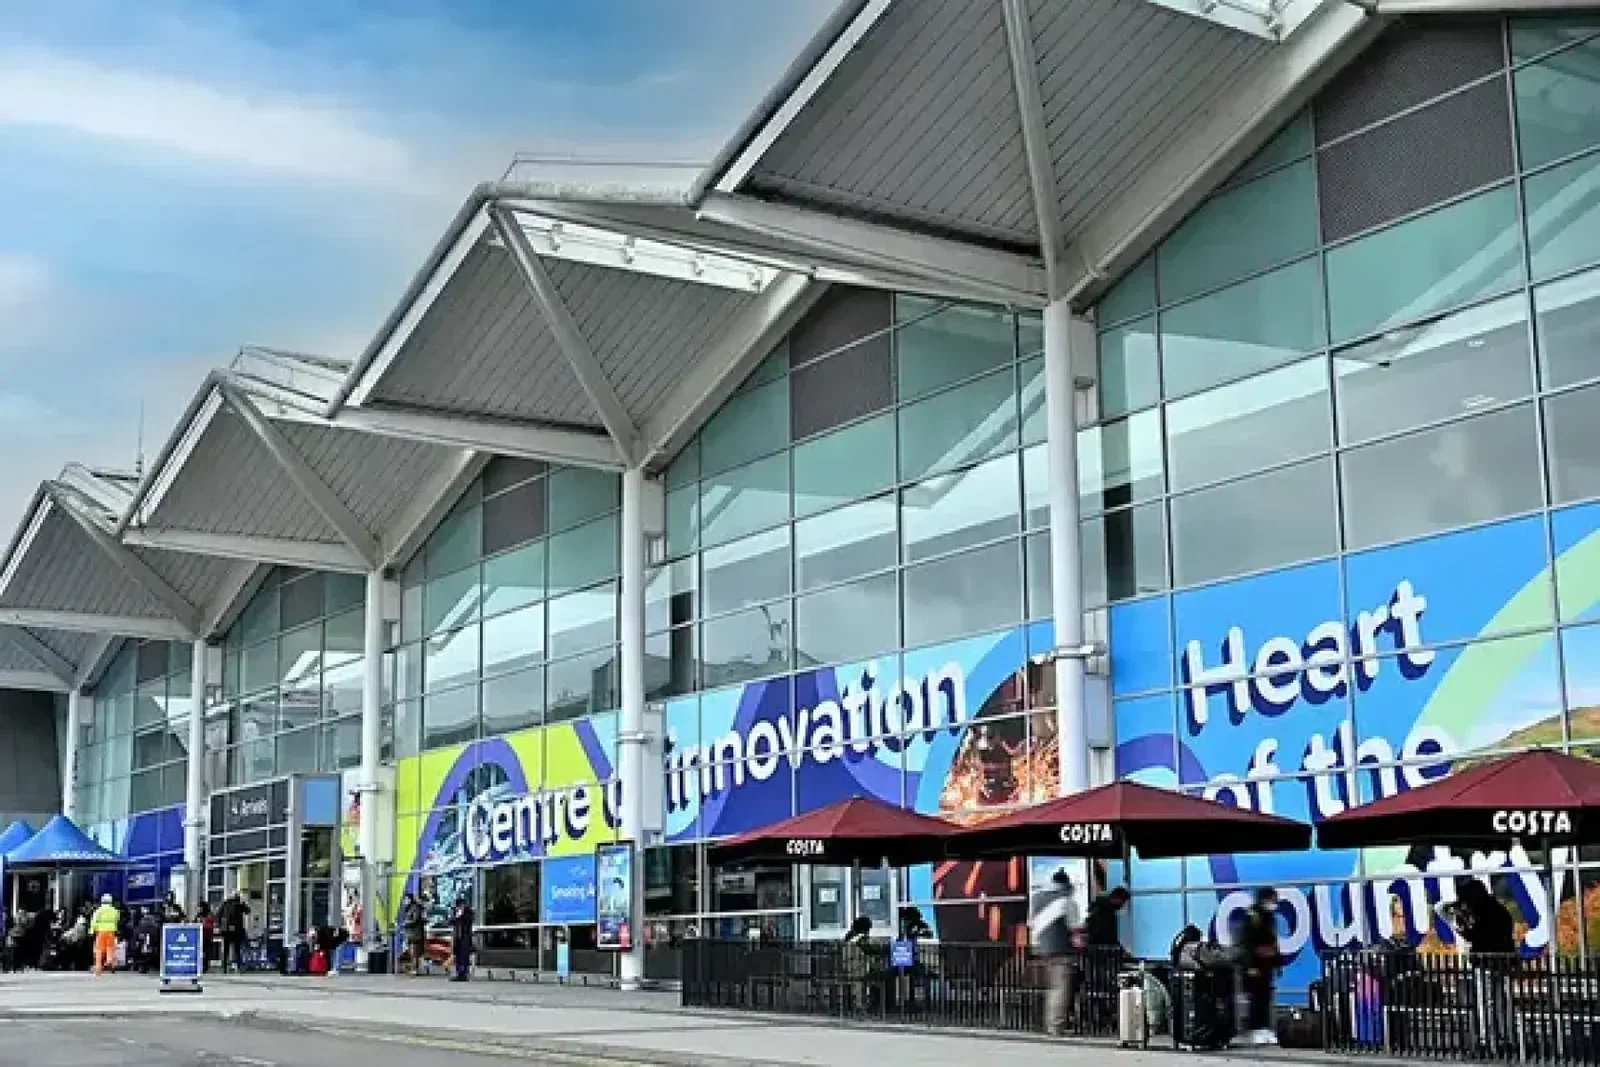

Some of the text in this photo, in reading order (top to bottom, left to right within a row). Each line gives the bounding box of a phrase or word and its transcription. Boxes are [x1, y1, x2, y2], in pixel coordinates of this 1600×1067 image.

[1184, 579, 1435, 728] Heart
[464, 784, 592, 860] Centre
[665, 660, 966, 806] innovation
[1301, 719, 1457, 820] the
[786, 839, 824, 856] COSTA
[1060, 823, 1112, 843] COSTA
[1493, 810, 1571, 835] COSTA
